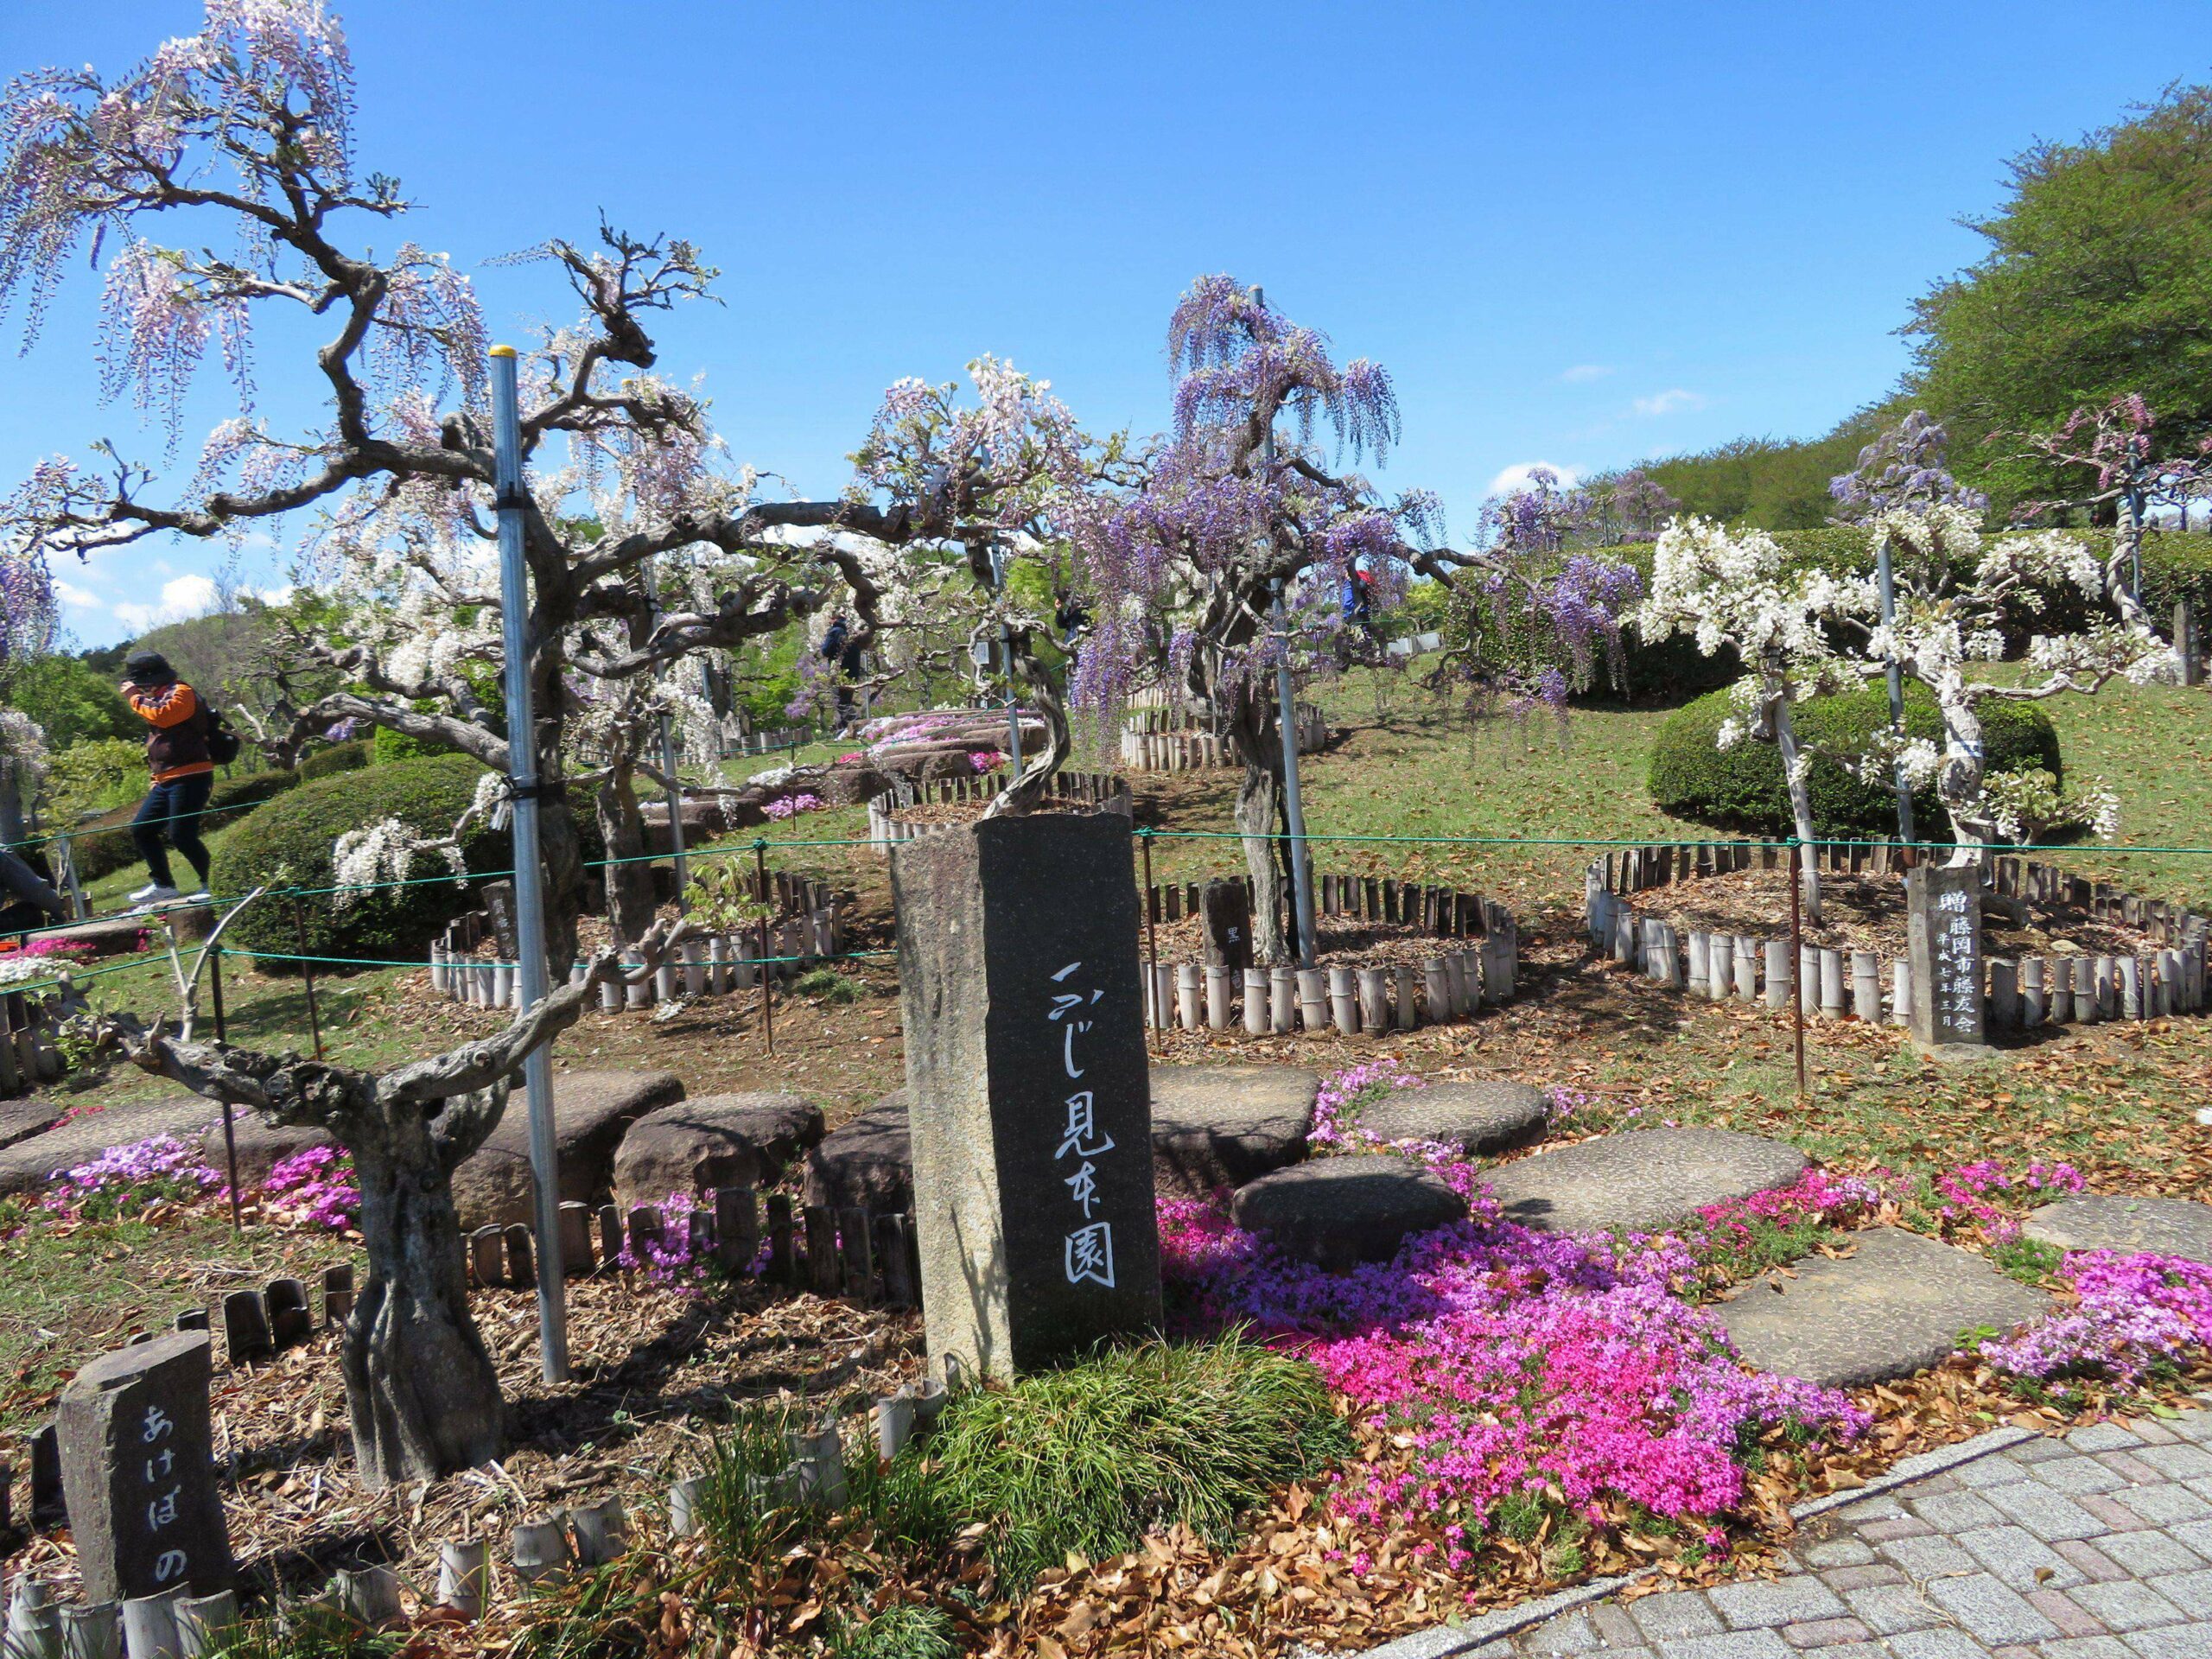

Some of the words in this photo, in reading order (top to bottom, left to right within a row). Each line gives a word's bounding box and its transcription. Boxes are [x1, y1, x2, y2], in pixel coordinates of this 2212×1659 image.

[1939, 891, 1967, 913] 贈
[1936, 932, 1953, 1027] 平成七年三月
[1950, 918, 1976, 1033] 藤岡市藤友会
[1048, 961, 1116, 1287] ふじ見本園
